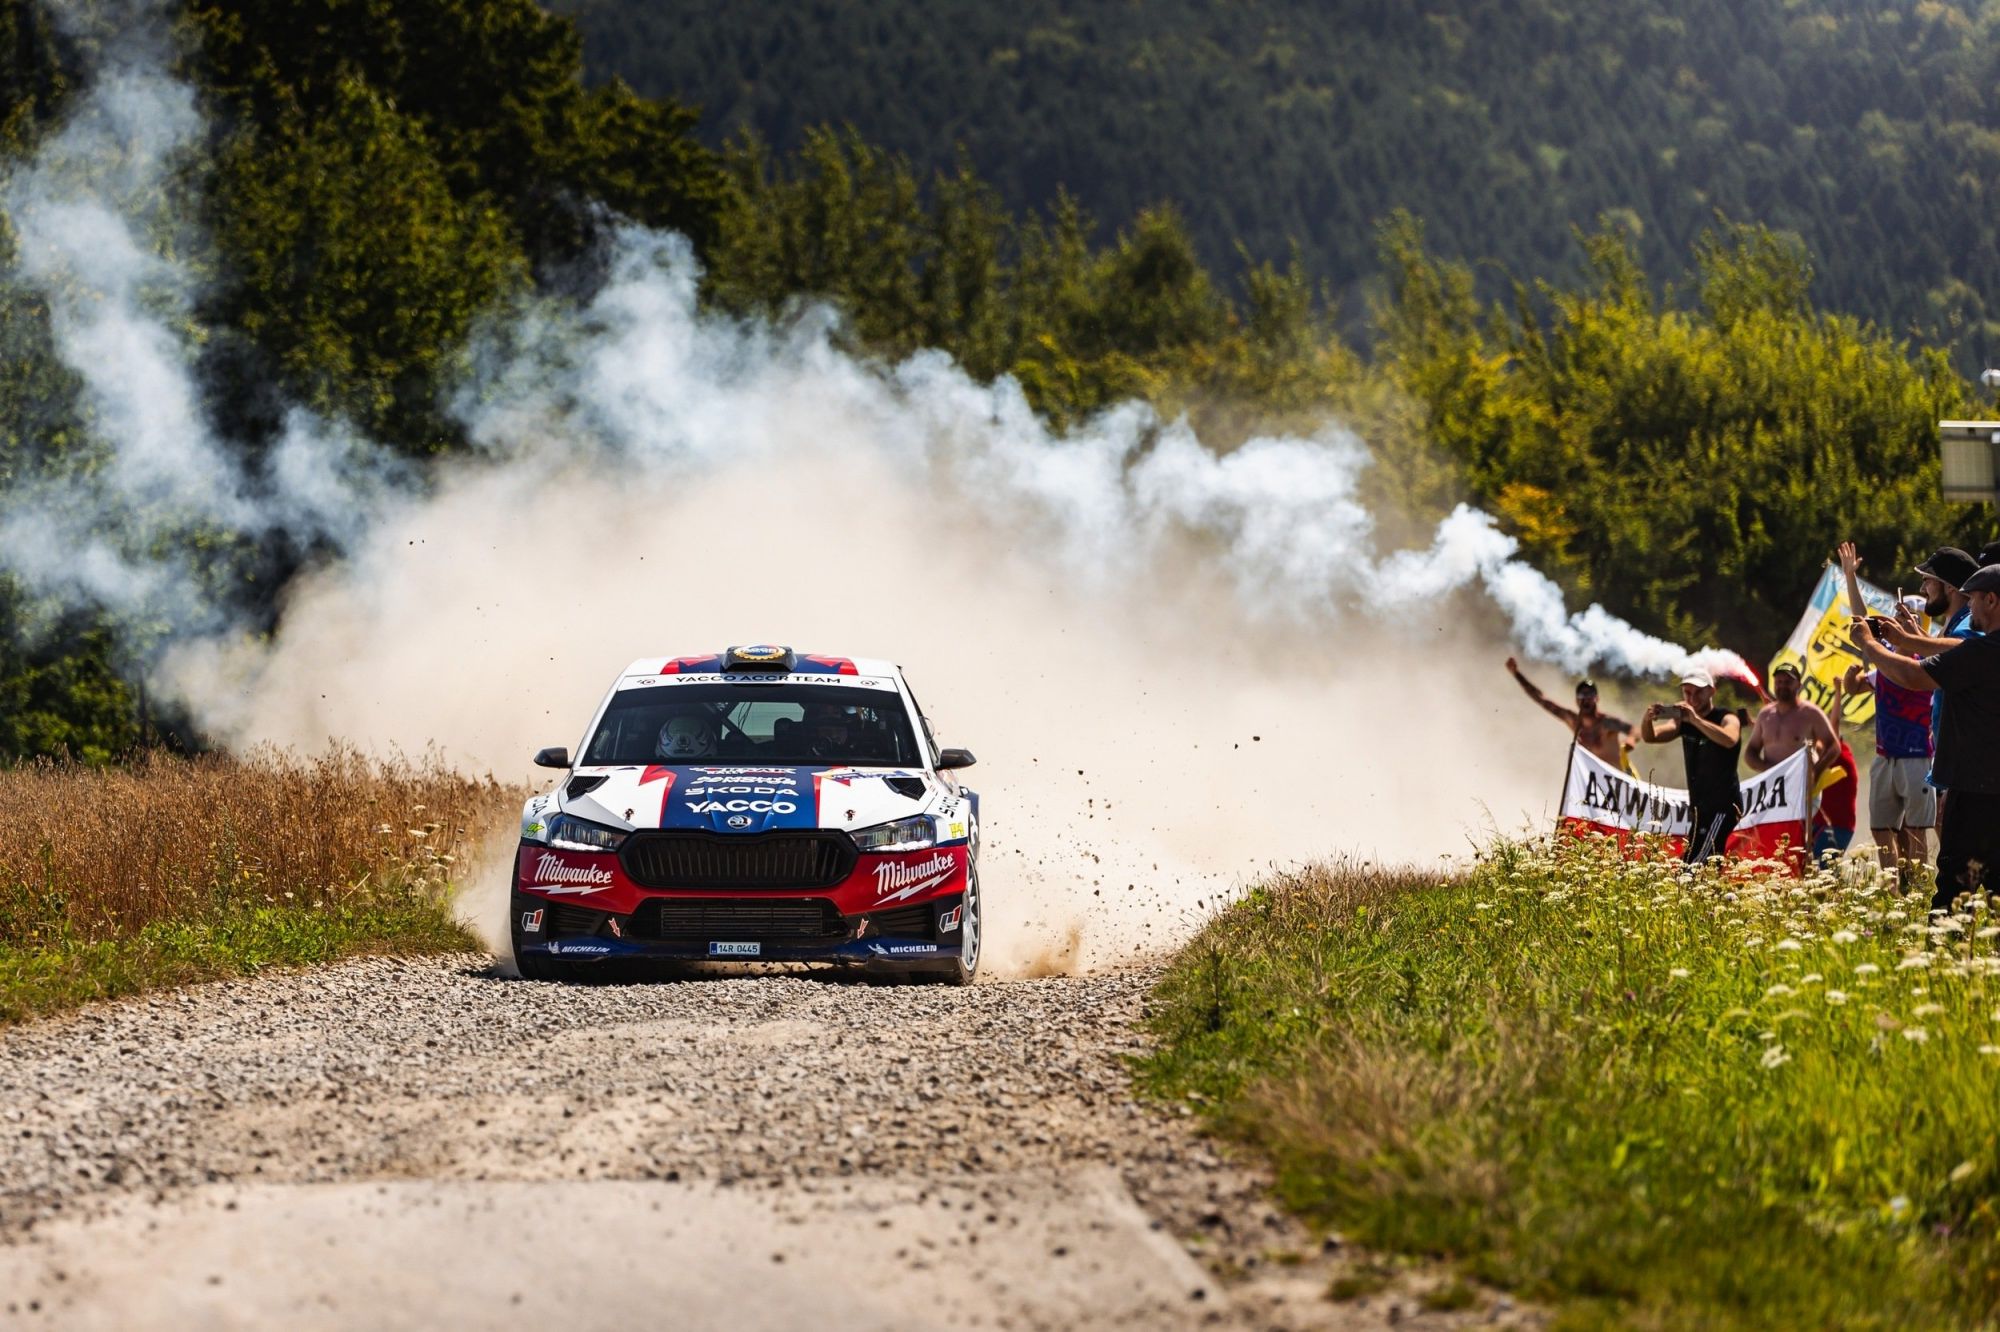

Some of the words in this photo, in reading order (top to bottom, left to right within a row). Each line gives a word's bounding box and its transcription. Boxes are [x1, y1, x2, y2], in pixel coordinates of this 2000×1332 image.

[676, 675, 735, 683] YACCO
[740, 675, 789, 683] ACCR
[792, 675, 841, 684] TEAM
[685, 800, 797, 814] YACCO
[534, 852, 613, 884] Milwaukee
[872, 852, 955, 896] Milwaukee
[561, 945, 611, 953] MICHELIN
[736, 944, 758, 953] 0445
[889, 944, 938, 953] MICHELIN
